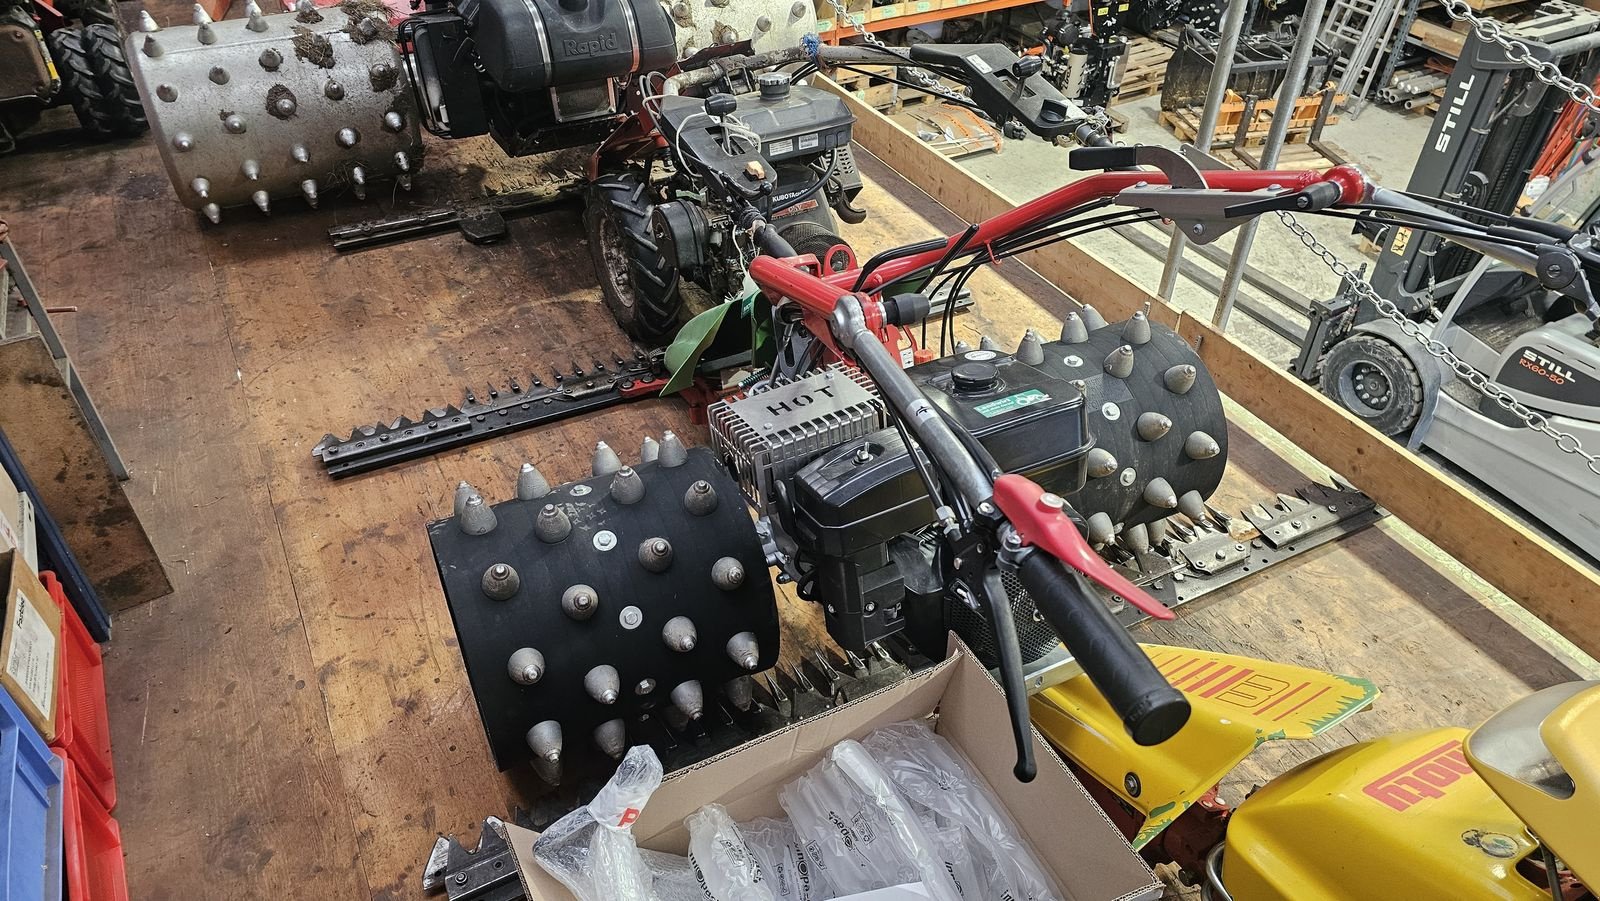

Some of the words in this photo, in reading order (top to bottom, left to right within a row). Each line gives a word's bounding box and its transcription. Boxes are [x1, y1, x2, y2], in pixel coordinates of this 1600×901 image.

[563, 32, 618, 57] Rapid
[1434, 74, 1475, 153] STILL
[1519, 358, 1565, 384] RX60-50
[1523, 349, 1576, 383] STILL
[766, 385, 834, 416] HOT
